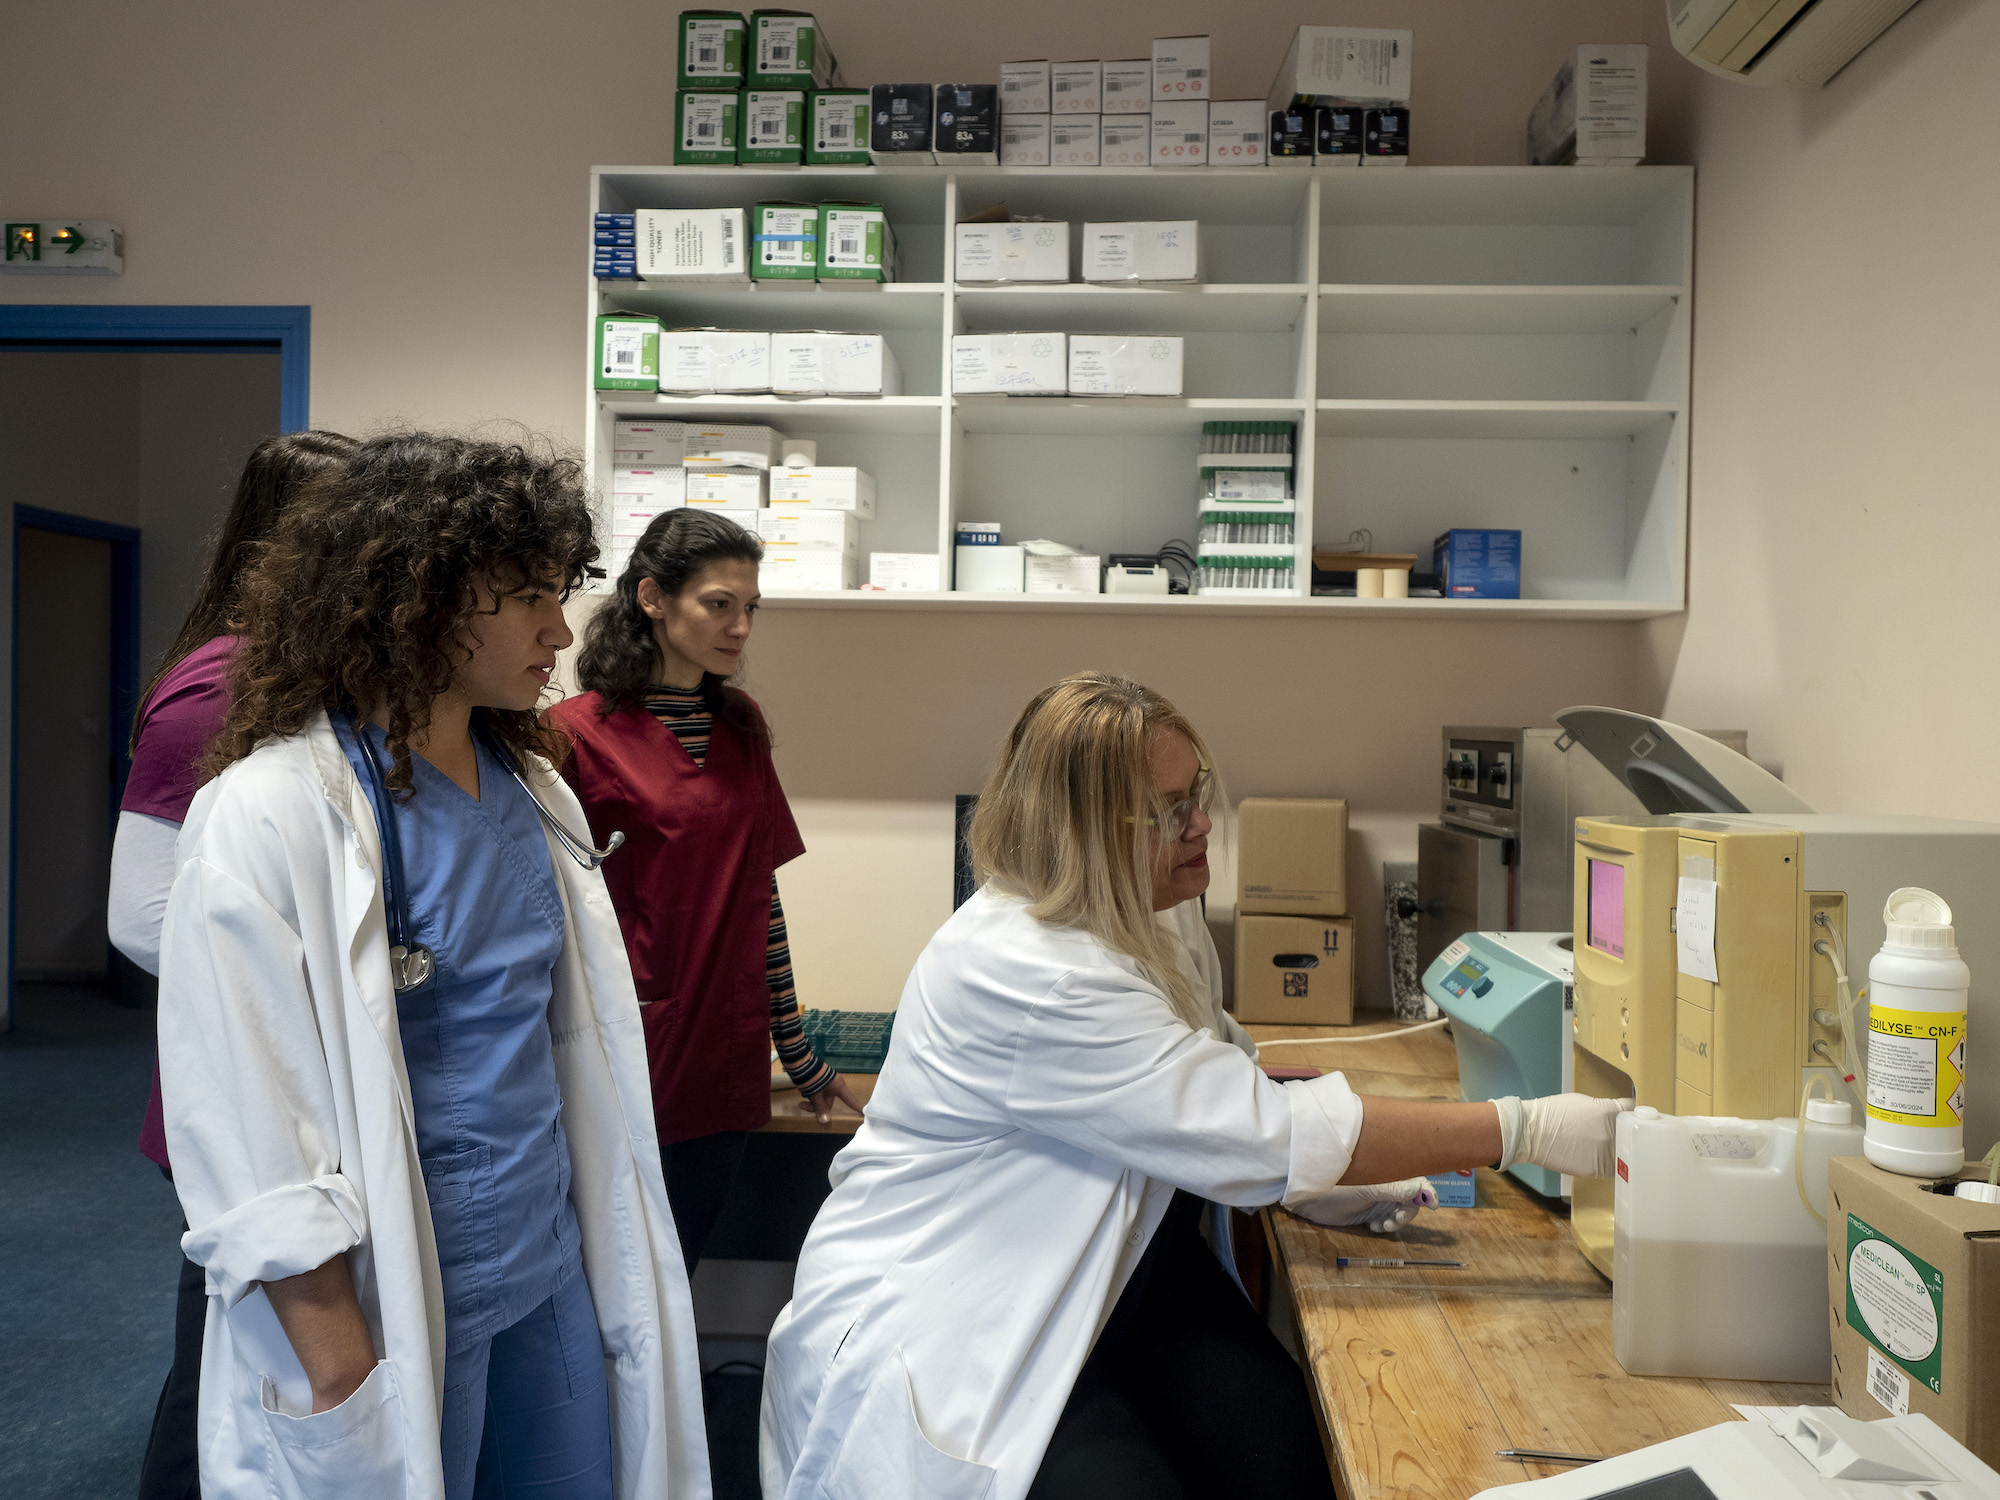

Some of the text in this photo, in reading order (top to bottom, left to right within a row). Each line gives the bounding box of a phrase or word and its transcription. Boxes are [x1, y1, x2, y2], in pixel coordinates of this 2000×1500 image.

[891, 131, 909, 140] 83A
[956, 131, 974, 140] 83A
[1929, 1026, 1957, 1036] CN-F
[1890, 1102, 1923, 1110] 30/06/2024
[1848, 1216, 1874, 1237] medicon
[1916, 1284, 1926, 1296] 5P
